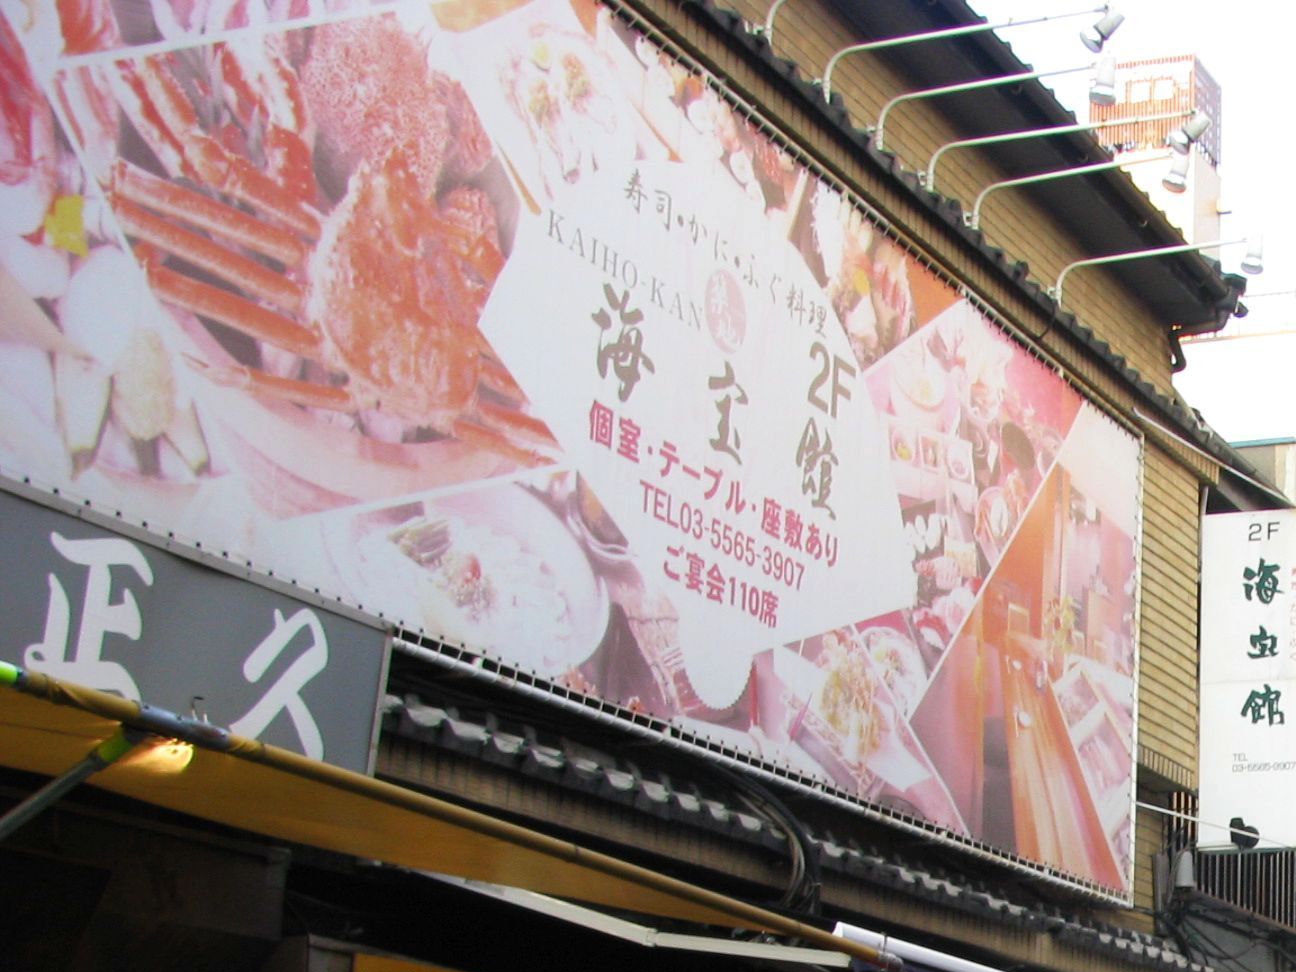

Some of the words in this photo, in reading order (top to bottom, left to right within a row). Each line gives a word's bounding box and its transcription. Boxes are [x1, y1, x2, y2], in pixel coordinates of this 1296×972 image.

[547, 209, 703, 332] KAIHO-KAN
[807, 341, 857, 419] 2F
[589, 400, 838, 568] 個室・テーブル・座敷あり
[1248, 522, 1280, 542] 2F
[663, 546, 779, 629] ご宴会110席
